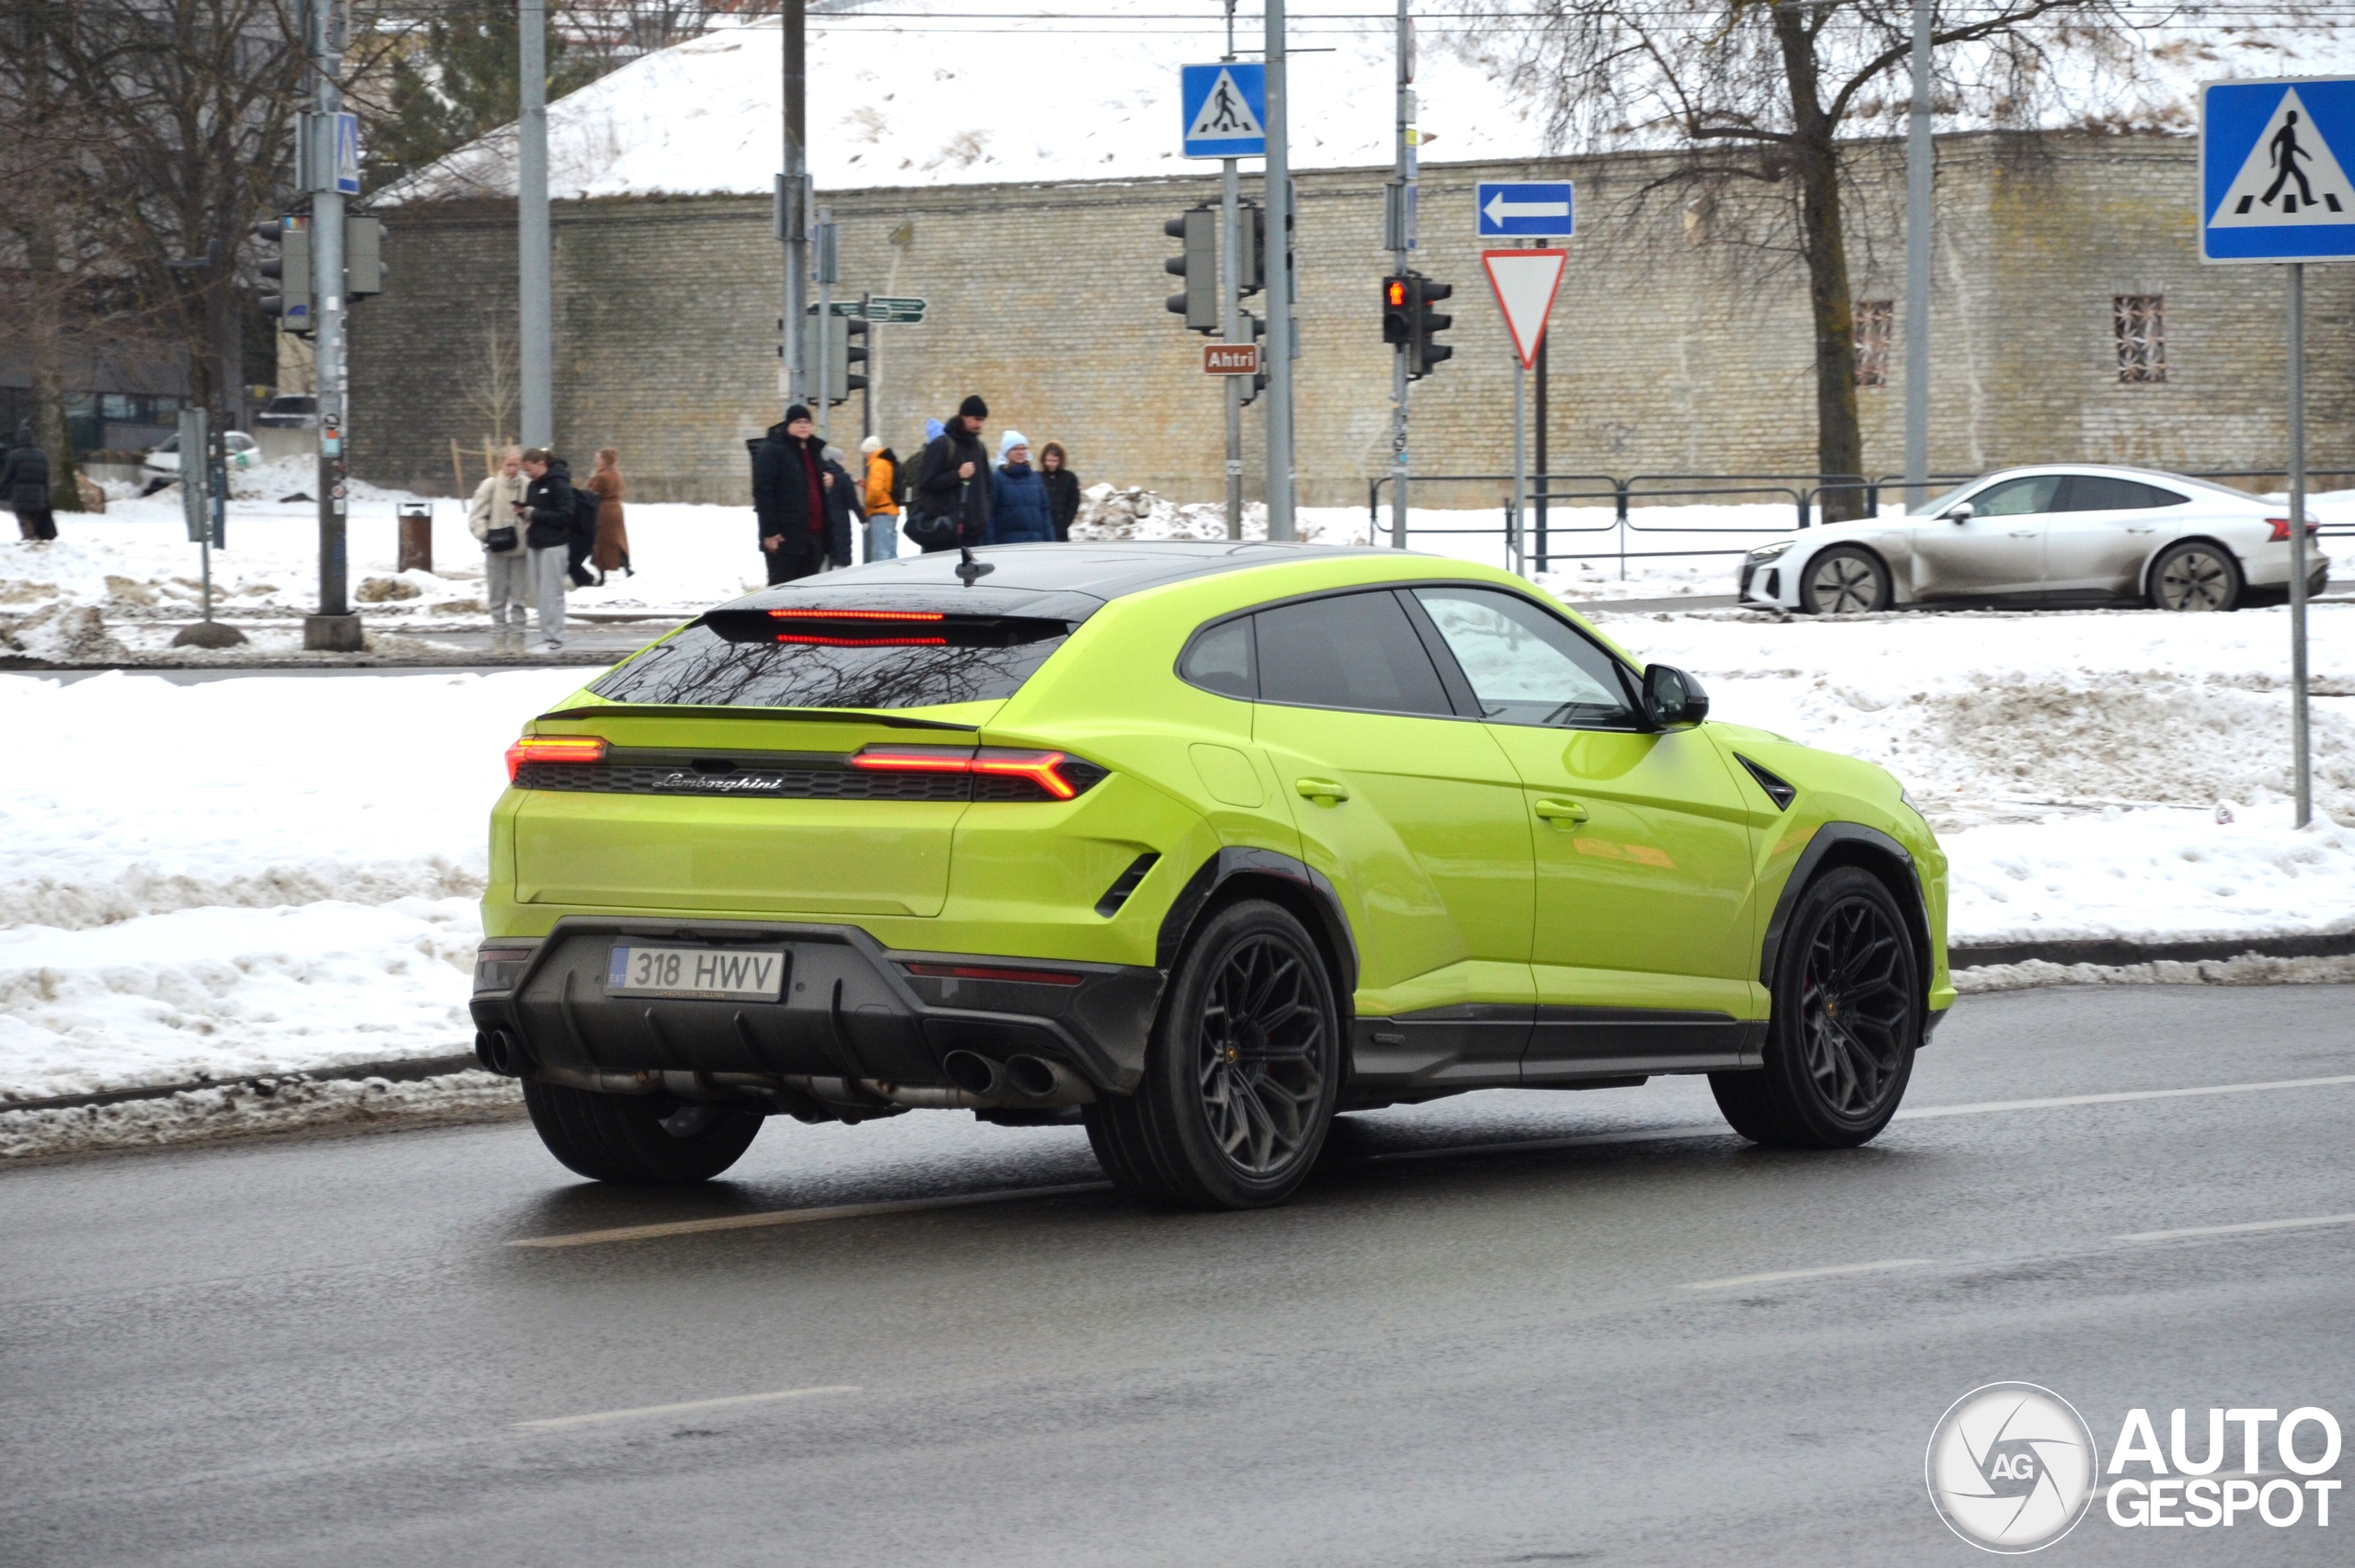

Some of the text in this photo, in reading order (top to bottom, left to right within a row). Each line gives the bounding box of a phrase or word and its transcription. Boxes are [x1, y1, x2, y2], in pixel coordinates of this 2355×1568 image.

[1207, 351, 1254, 367] Ahtri
[652, 773, 782, 791] Lamborghini
[609, 973, 626, 983] EST
[634, 953, 773, 990] 318 HWV
